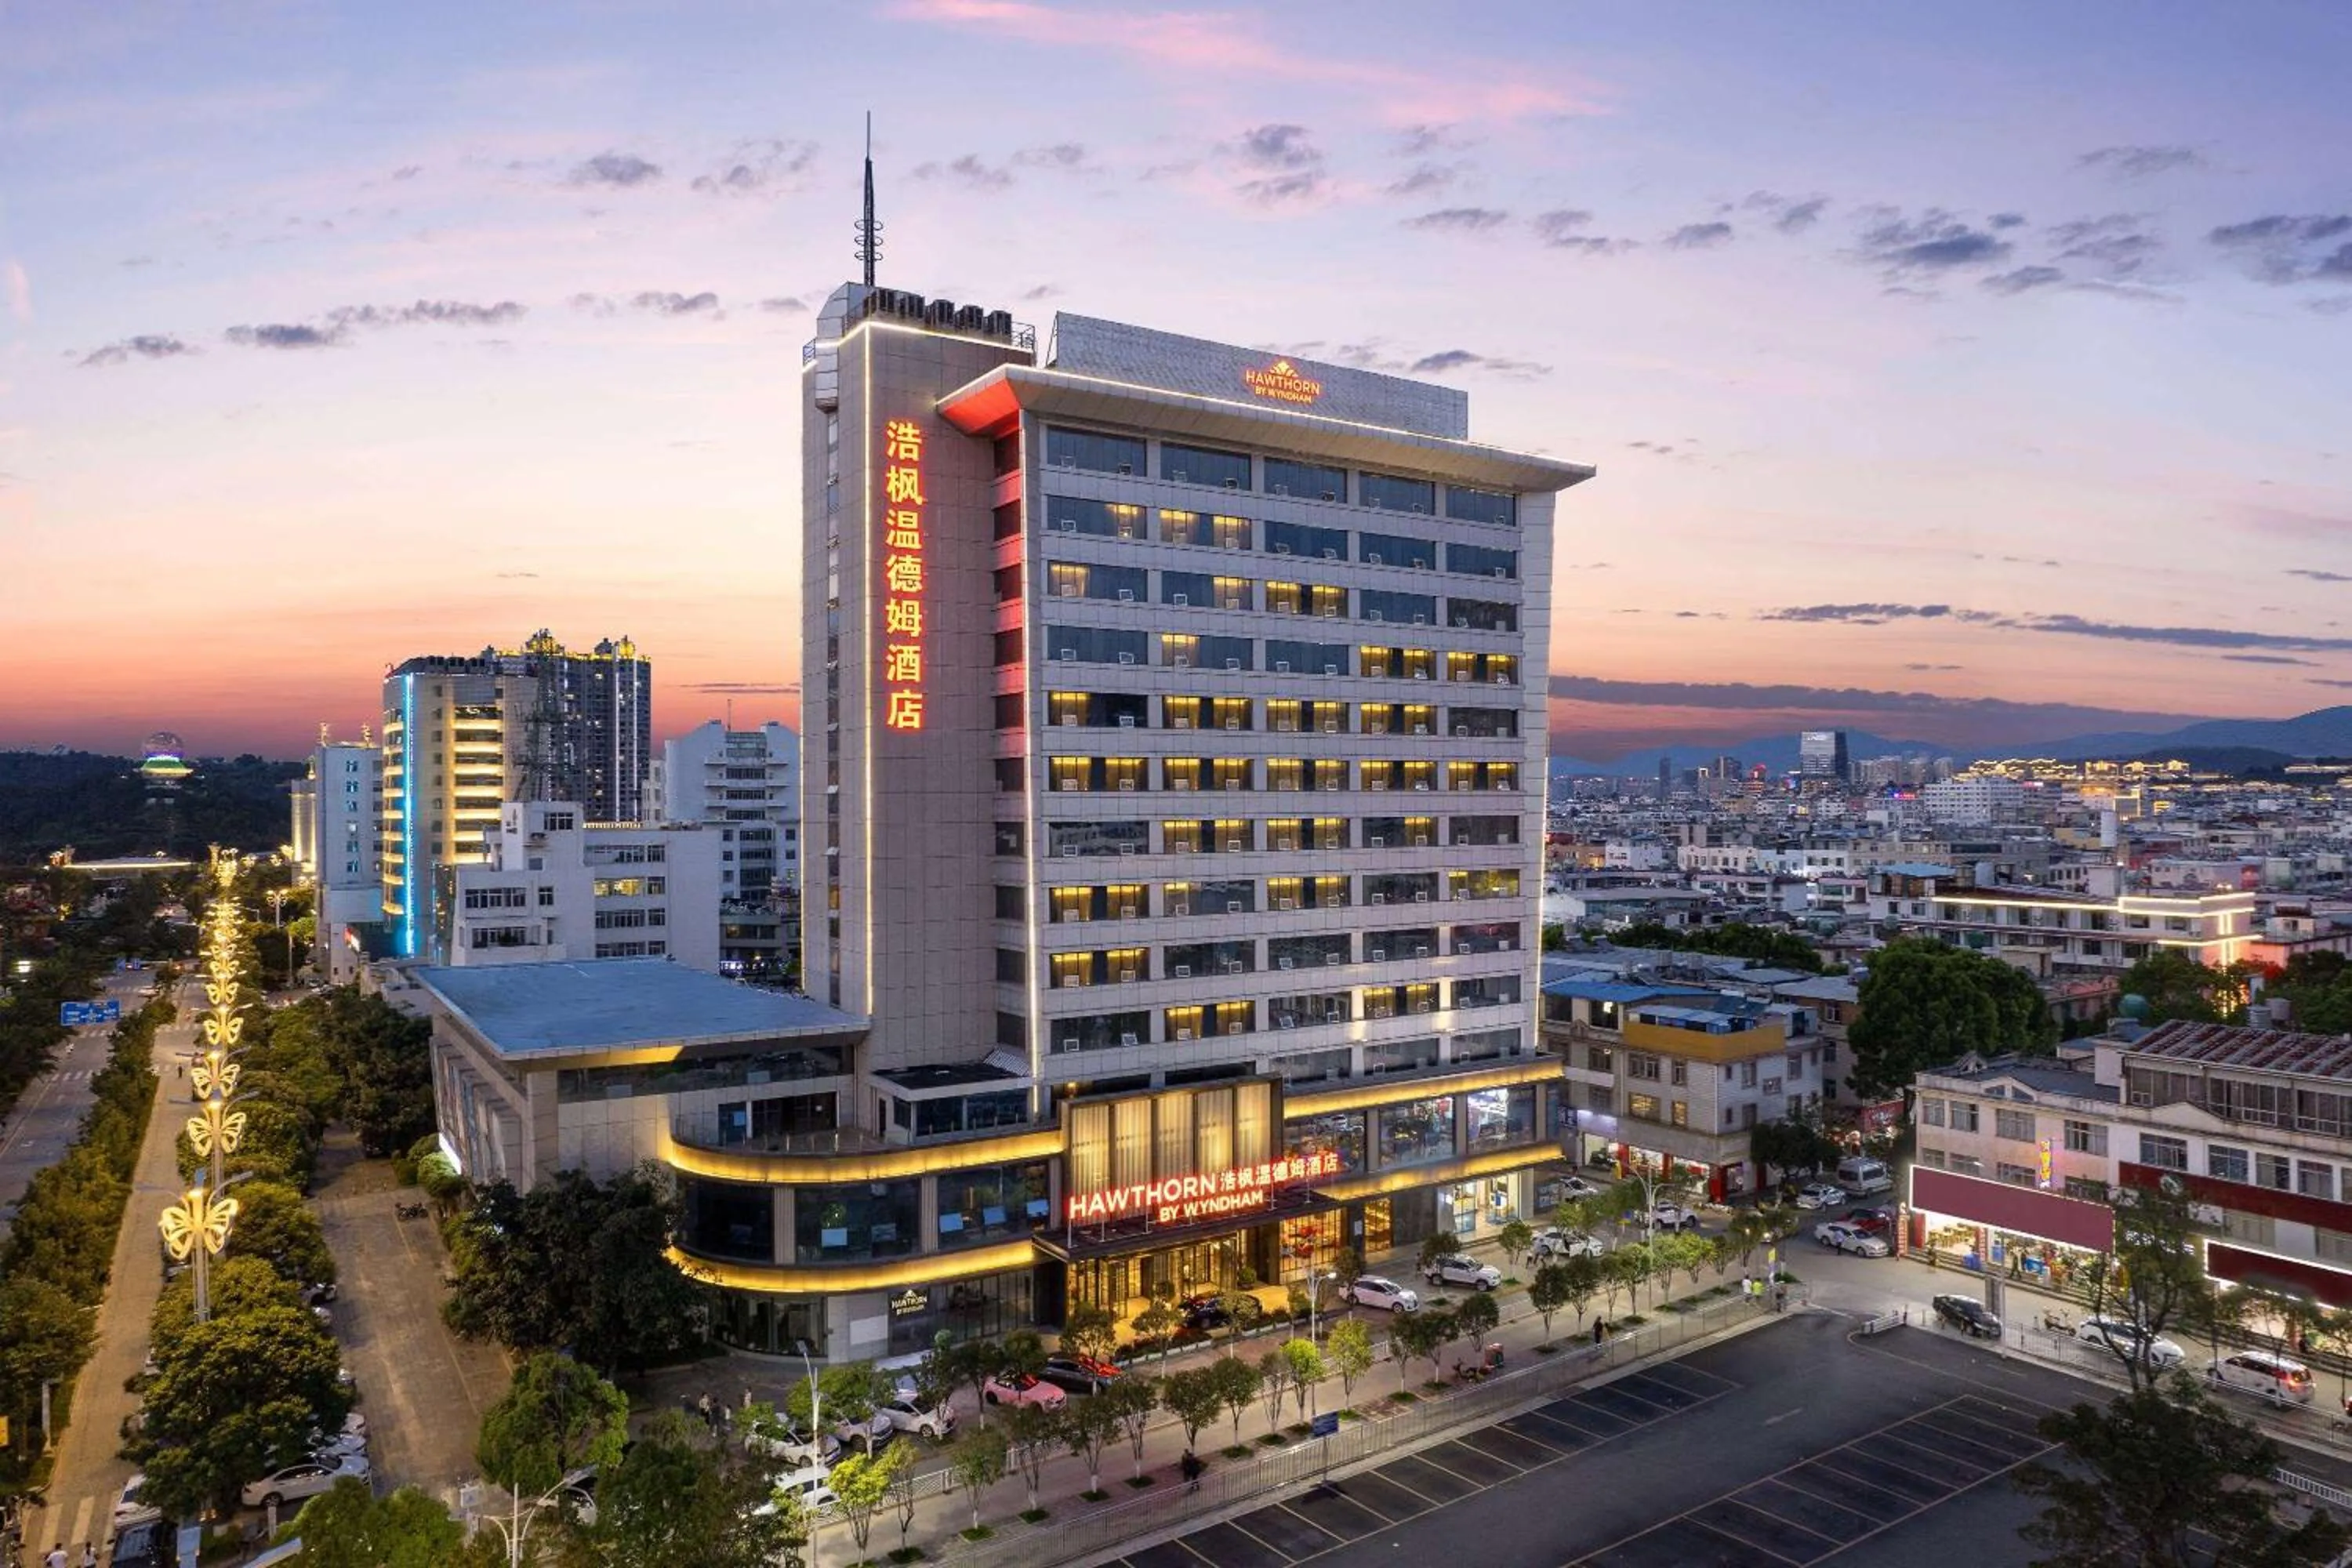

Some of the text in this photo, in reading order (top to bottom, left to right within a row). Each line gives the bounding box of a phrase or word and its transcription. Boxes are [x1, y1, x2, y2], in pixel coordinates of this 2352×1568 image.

[1246, 369, 1320, 395] HAWTHORN
[885, 420, 923, 729] 浩枫温德姆酒店
[1069, 1152, 1338, 1220] HAWTHORN 浩枫温德姆酒店
[1160, 1190, 1264, 1222] BY WYNDHAM
